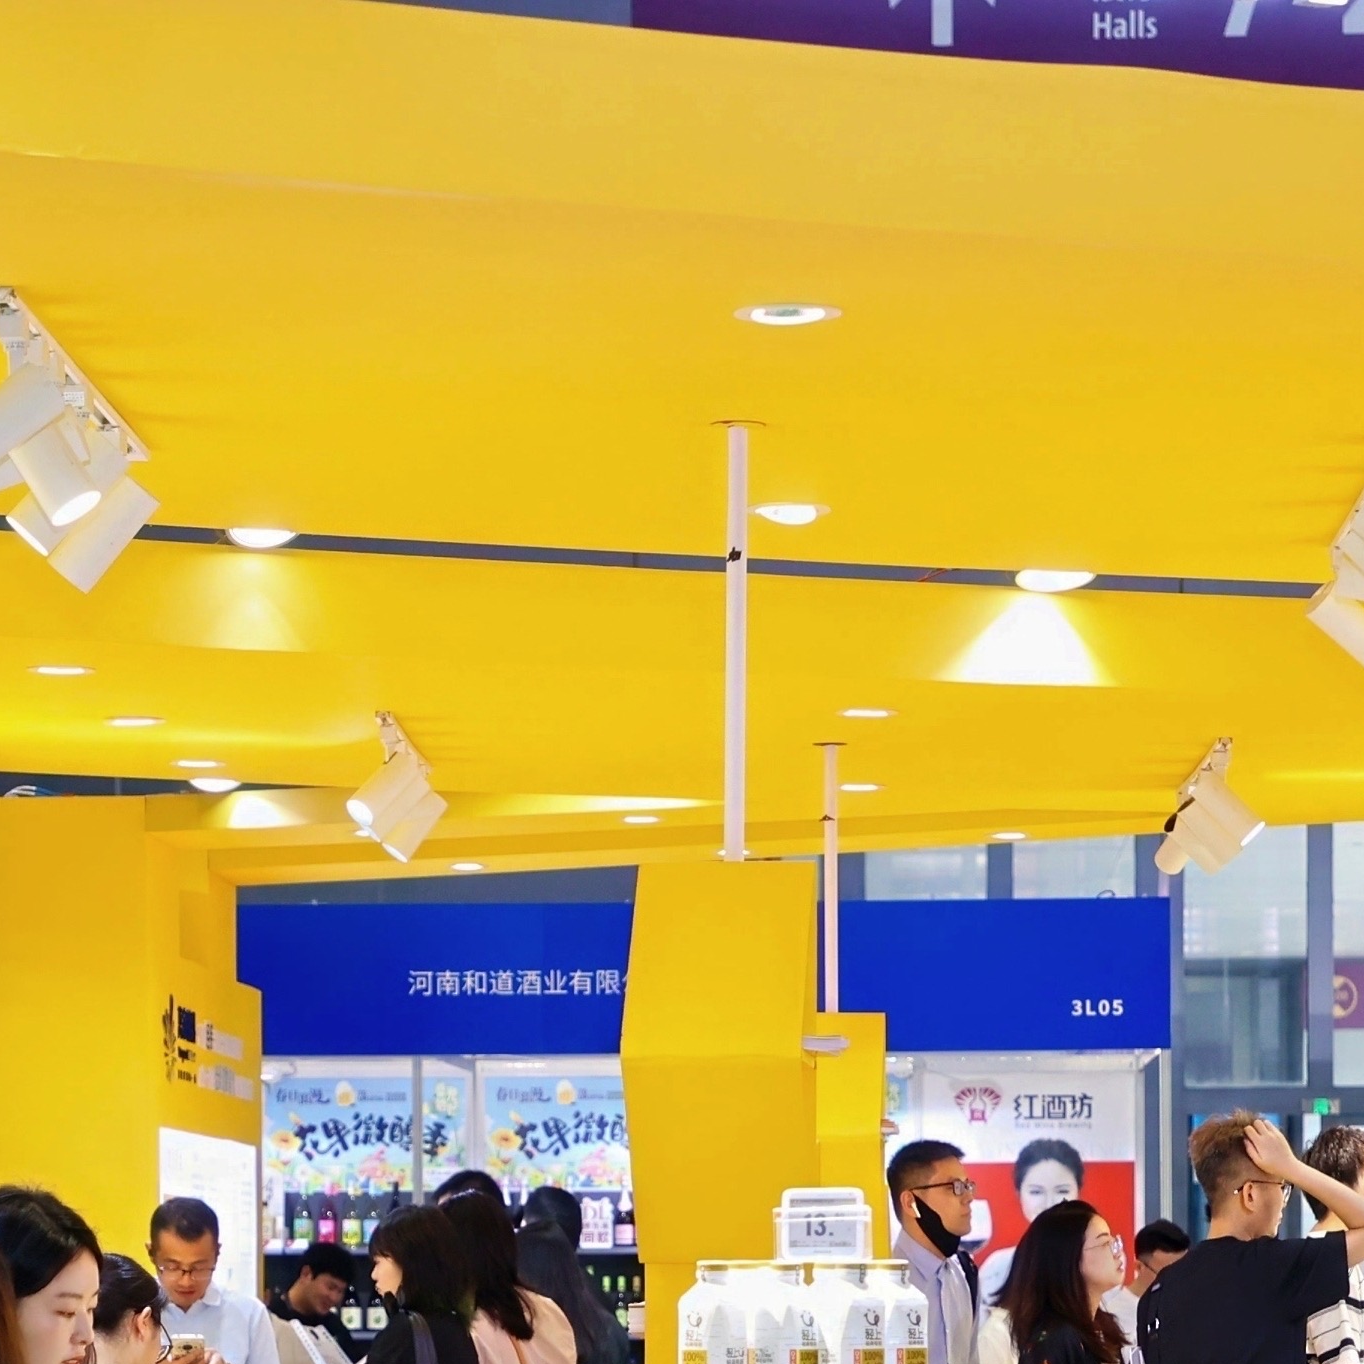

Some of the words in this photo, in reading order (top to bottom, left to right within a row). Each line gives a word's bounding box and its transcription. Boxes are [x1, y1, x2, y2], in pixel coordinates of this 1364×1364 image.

[1092, 12, 1159, 40] Halls
[1070, 999, 1124, 1016] 3L05
[1014, 1092, 1093, 1119] 红酒坊
